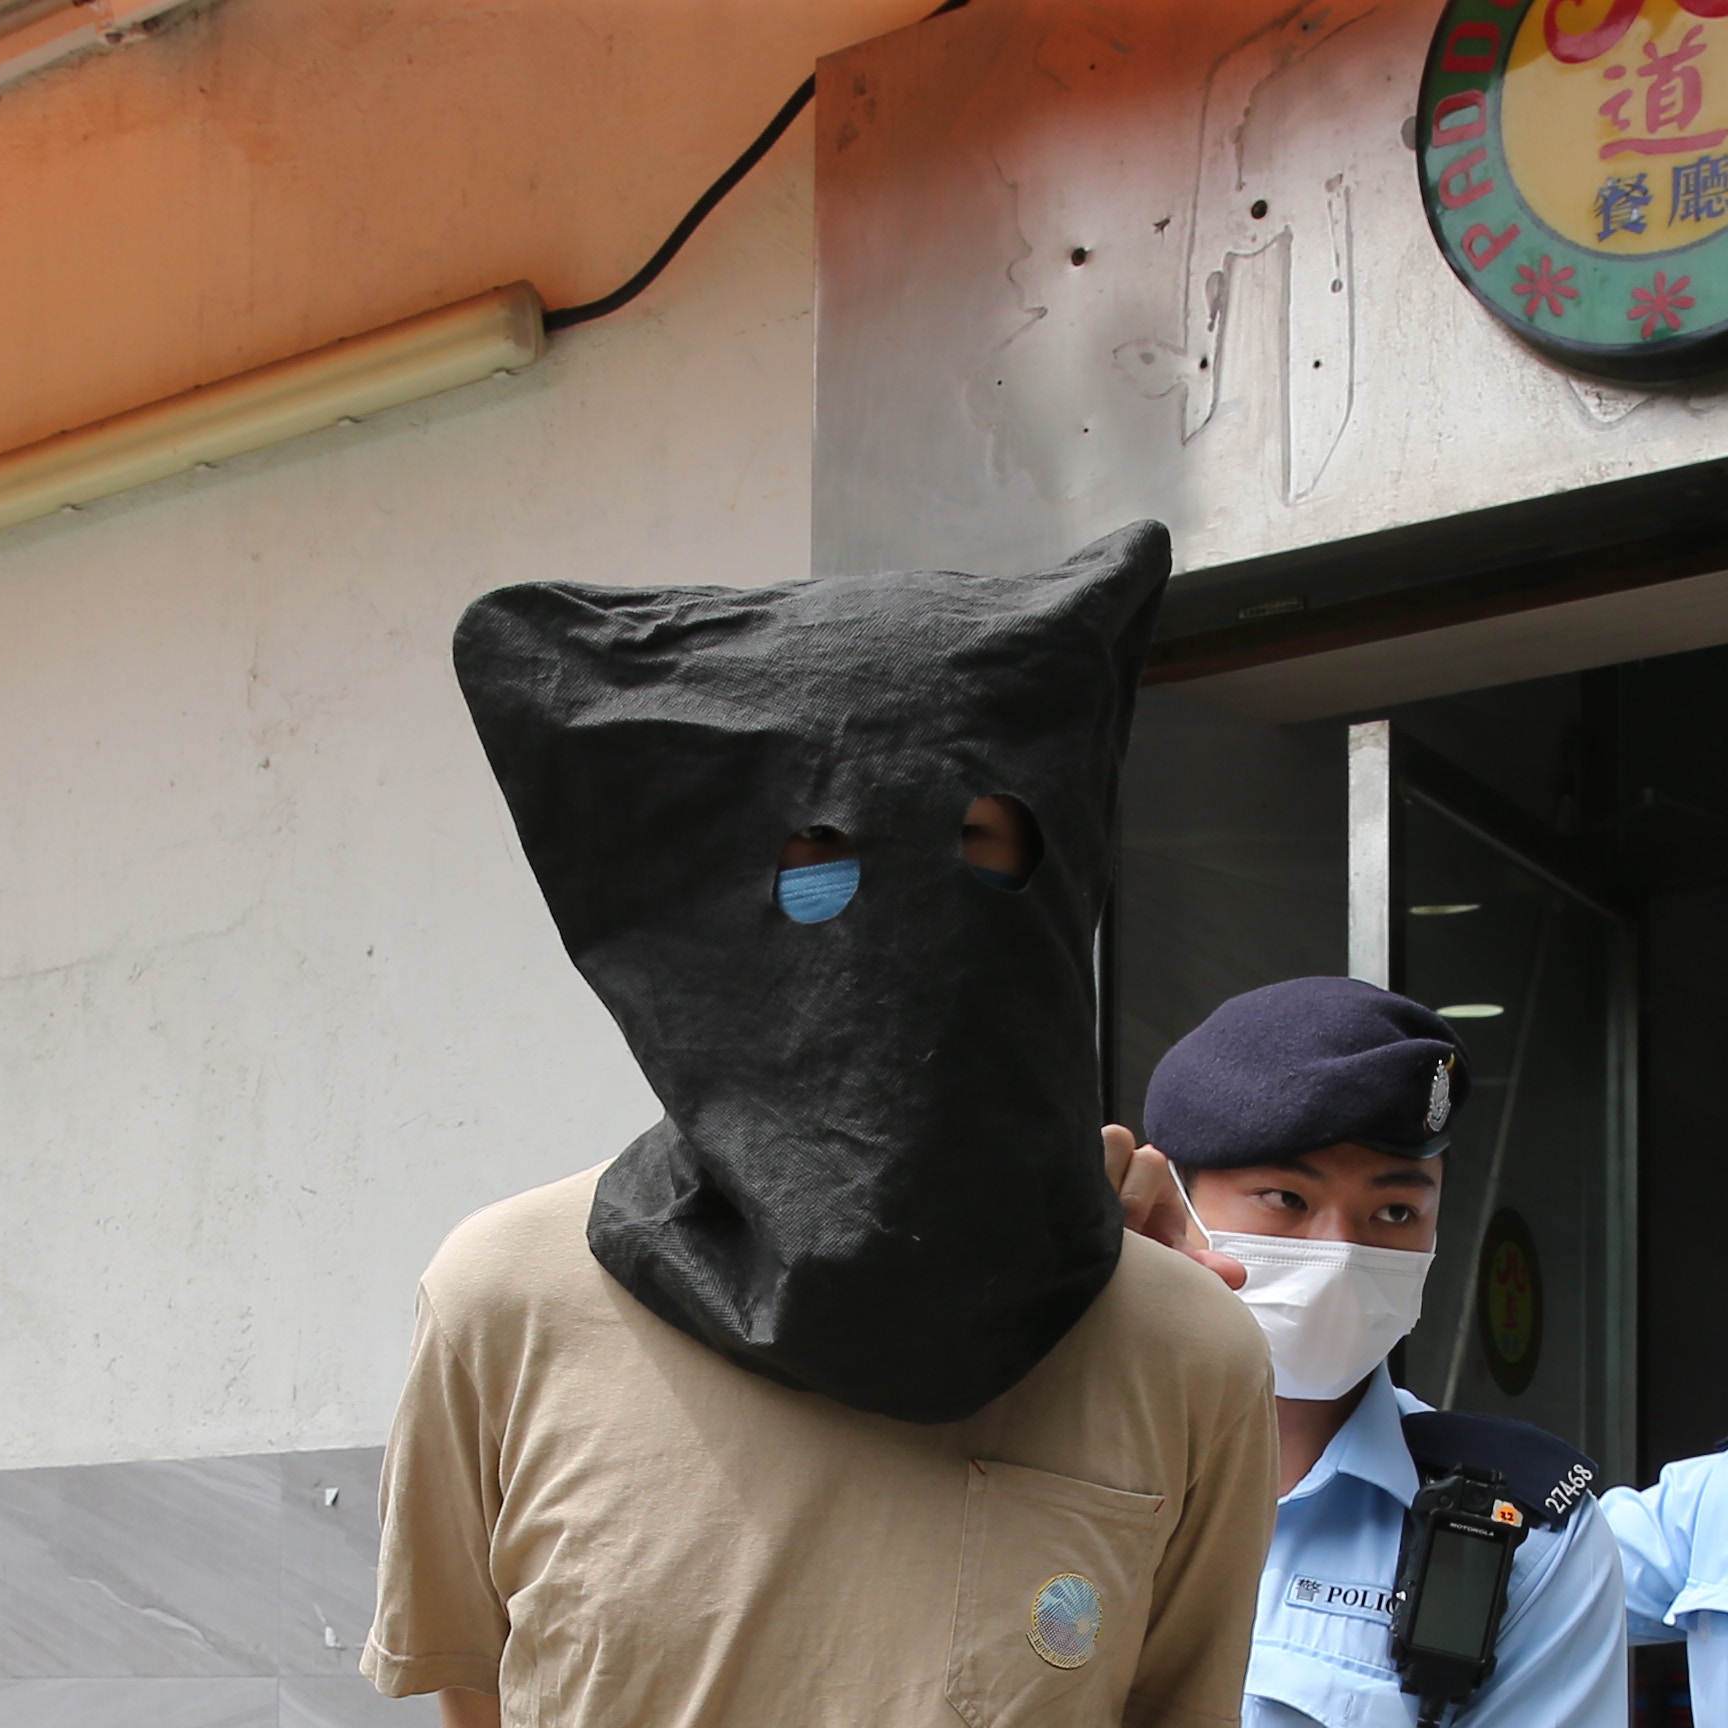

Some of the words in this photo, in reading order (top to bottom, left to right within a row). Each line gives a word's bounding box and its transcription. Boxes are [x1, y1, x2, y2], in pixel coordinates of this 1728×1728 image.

[1432, 0, 1520, 271] PADD
[1544, 1463, 1594, 1515] 27468
[1449, 1522, 1495, 1538] MOTOROLA
